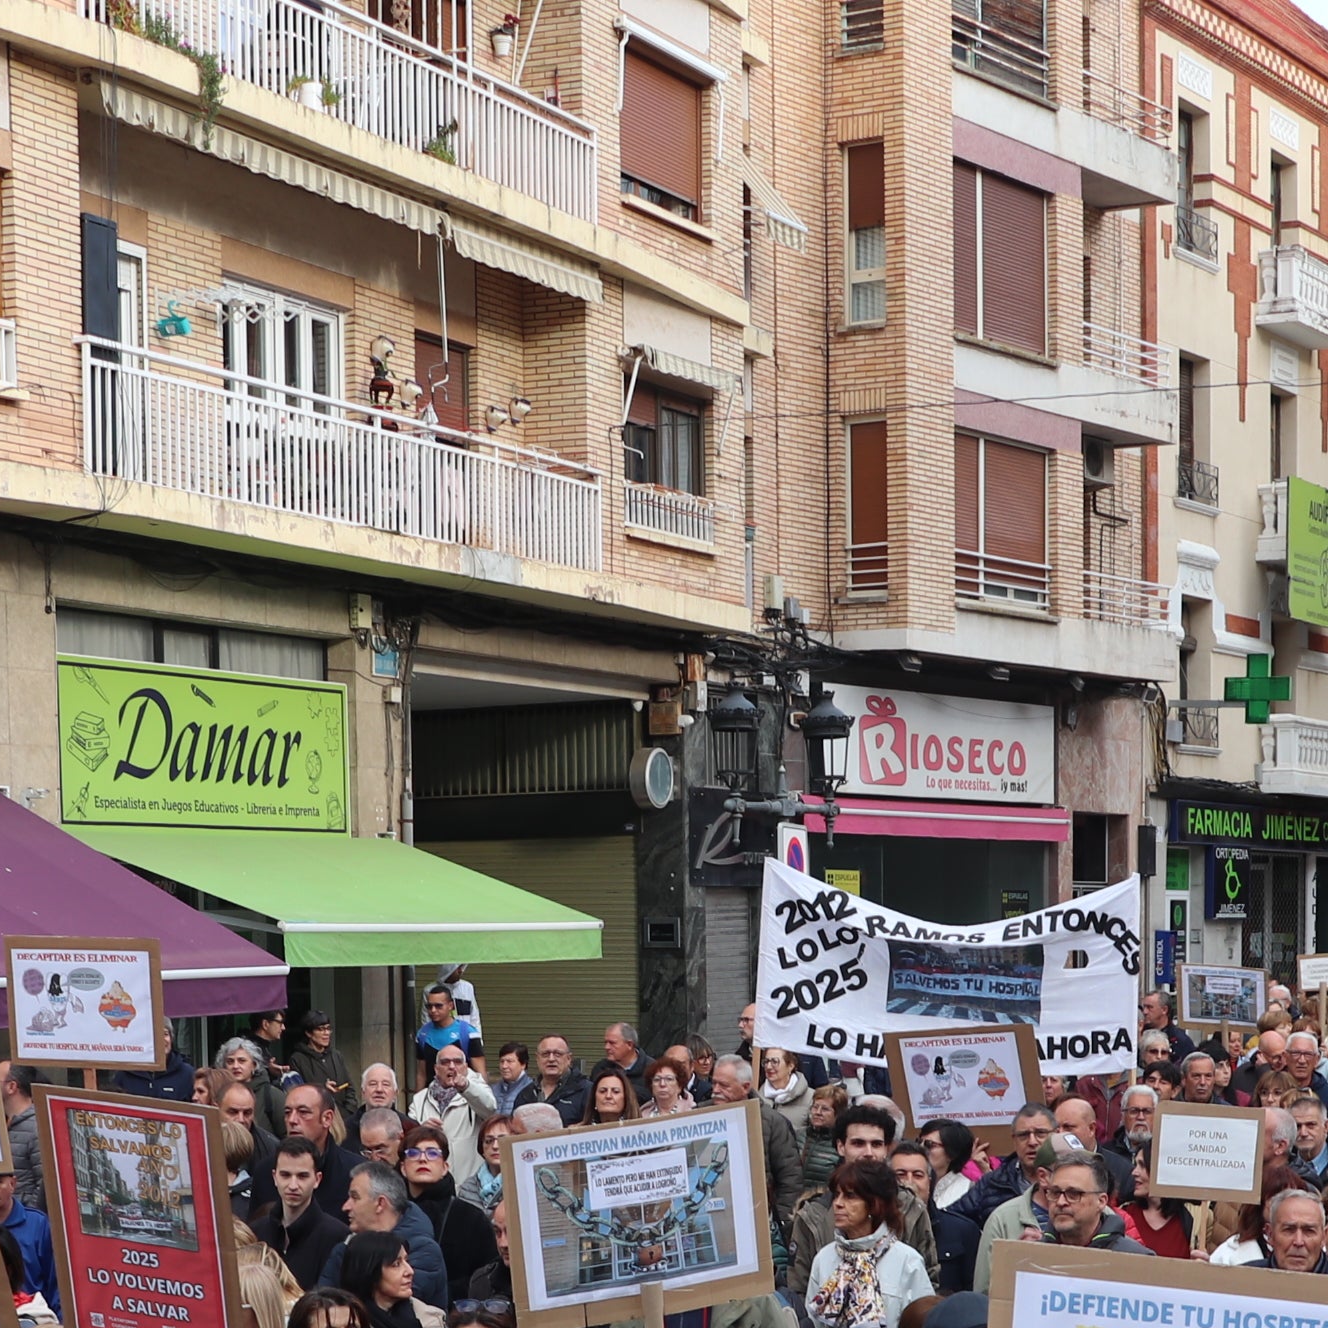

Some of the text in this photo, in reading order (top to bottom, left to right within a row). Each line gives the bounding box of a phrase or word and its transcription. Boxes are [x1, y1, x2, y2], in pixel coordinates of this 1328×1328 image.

[113, 688, 302, 788] Damar
[861, 720, 1026, 784] RIOSECO
[926, 775, 936, 789] Lo
[938, 778, 952, 791] que
[954, 778, 997, 792] necesitas...
[94, 796, 146, 812] Especialista
[149, 802, 159, 811] en
[161, 799, 192, 815] Juegos
[195, 800, 239, 814] Educativos
[279, 807, 283, 815] e
[285, 804, 320, 818] Imprenta
[1187, 807, 1253, 839] FARMACIA
[1262, 811, 1319, 841] JIMÉNEZ
[1216, 848, 1249, 860] ORTOPEDIA
[775, 890, 857, 935] 2012
[777, 938, 818, 970] LO
[1002, 908, 1140, 976] ENTONCES
[17, 953, 137, 962] DECAPITAR ES ELIMINAR
[771, 958, 868, 1019] 2025
[895, 972, 959, 990] SALVEMOS
[963, 977, 983, 991] TU
[807, 1024, 847, 1050] LO
[905, 1036, 1006, 1047] DECAPITAR ELIMINAR
[76, 1112, 182, 1139] ENTONCES LO
[1189, 1130, 1228, 1139] POR UNA
[89, 1137, 173, 1160] SALVAMOS
[545, 1119, 727, 1160] HOY DERIVAN MAÑANA PRIVATIZAN
[1188, 1144, 1226, 1153] SANIDAD
[1167, 1157, 1246, 1169] DESCENTRALIZADA
[626, 1173, 638, 1183] PERO
[646, 1171, 656, 1181] HAN
[137, 1181, 181, 1210] 2012
[122, 1249, 159, 1268] 2025
[88, 1268, 205, 1301] LO VOLVEMOS
[112, 1297, 190, 1322] A SALVAR
[1040, 1290, 1174, 1325] ¡DEFIENDE
[1181, 1304, 1215, 1328] TU
